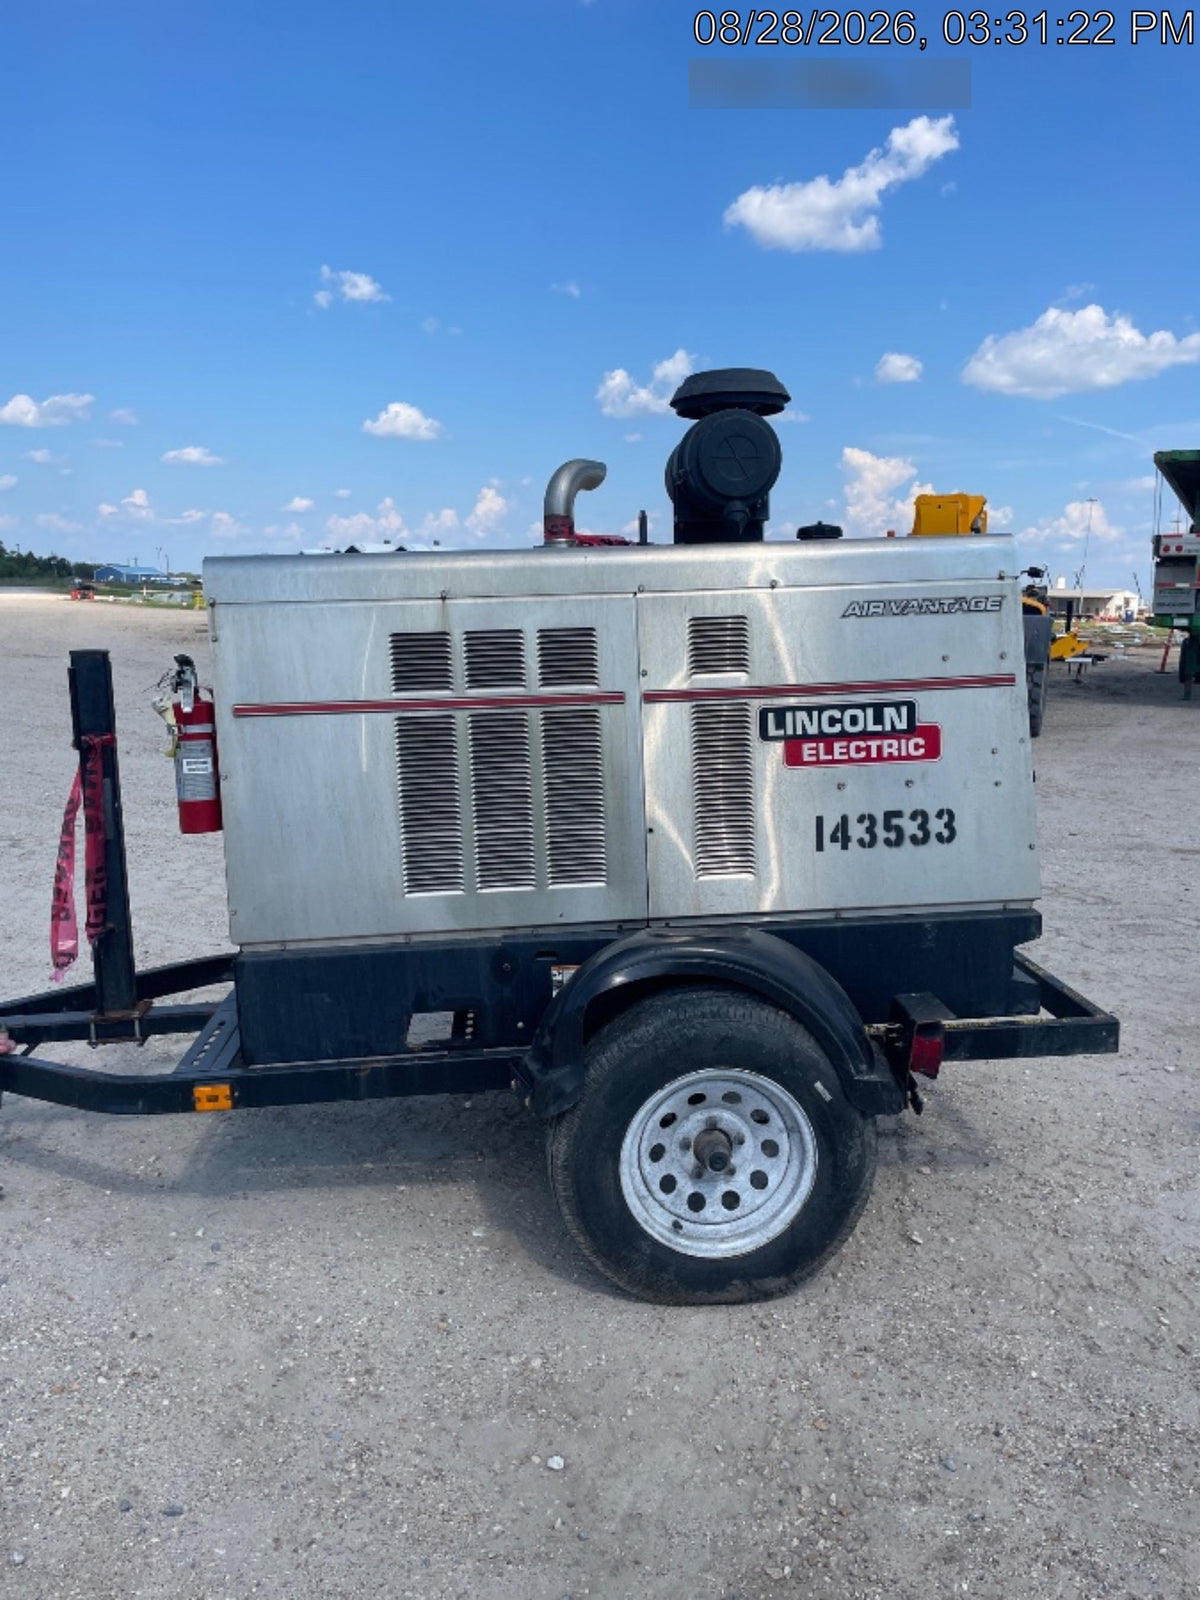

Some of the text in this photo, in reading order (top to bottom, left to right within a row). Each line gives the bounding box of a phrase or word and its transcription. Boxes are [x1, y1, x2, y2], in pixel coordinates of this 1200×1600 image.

[767, 705, 908, 737] LINCOLN
[802, 737, 926, 762] ELECTRIC
[815, 808, 957, 852] 143533
